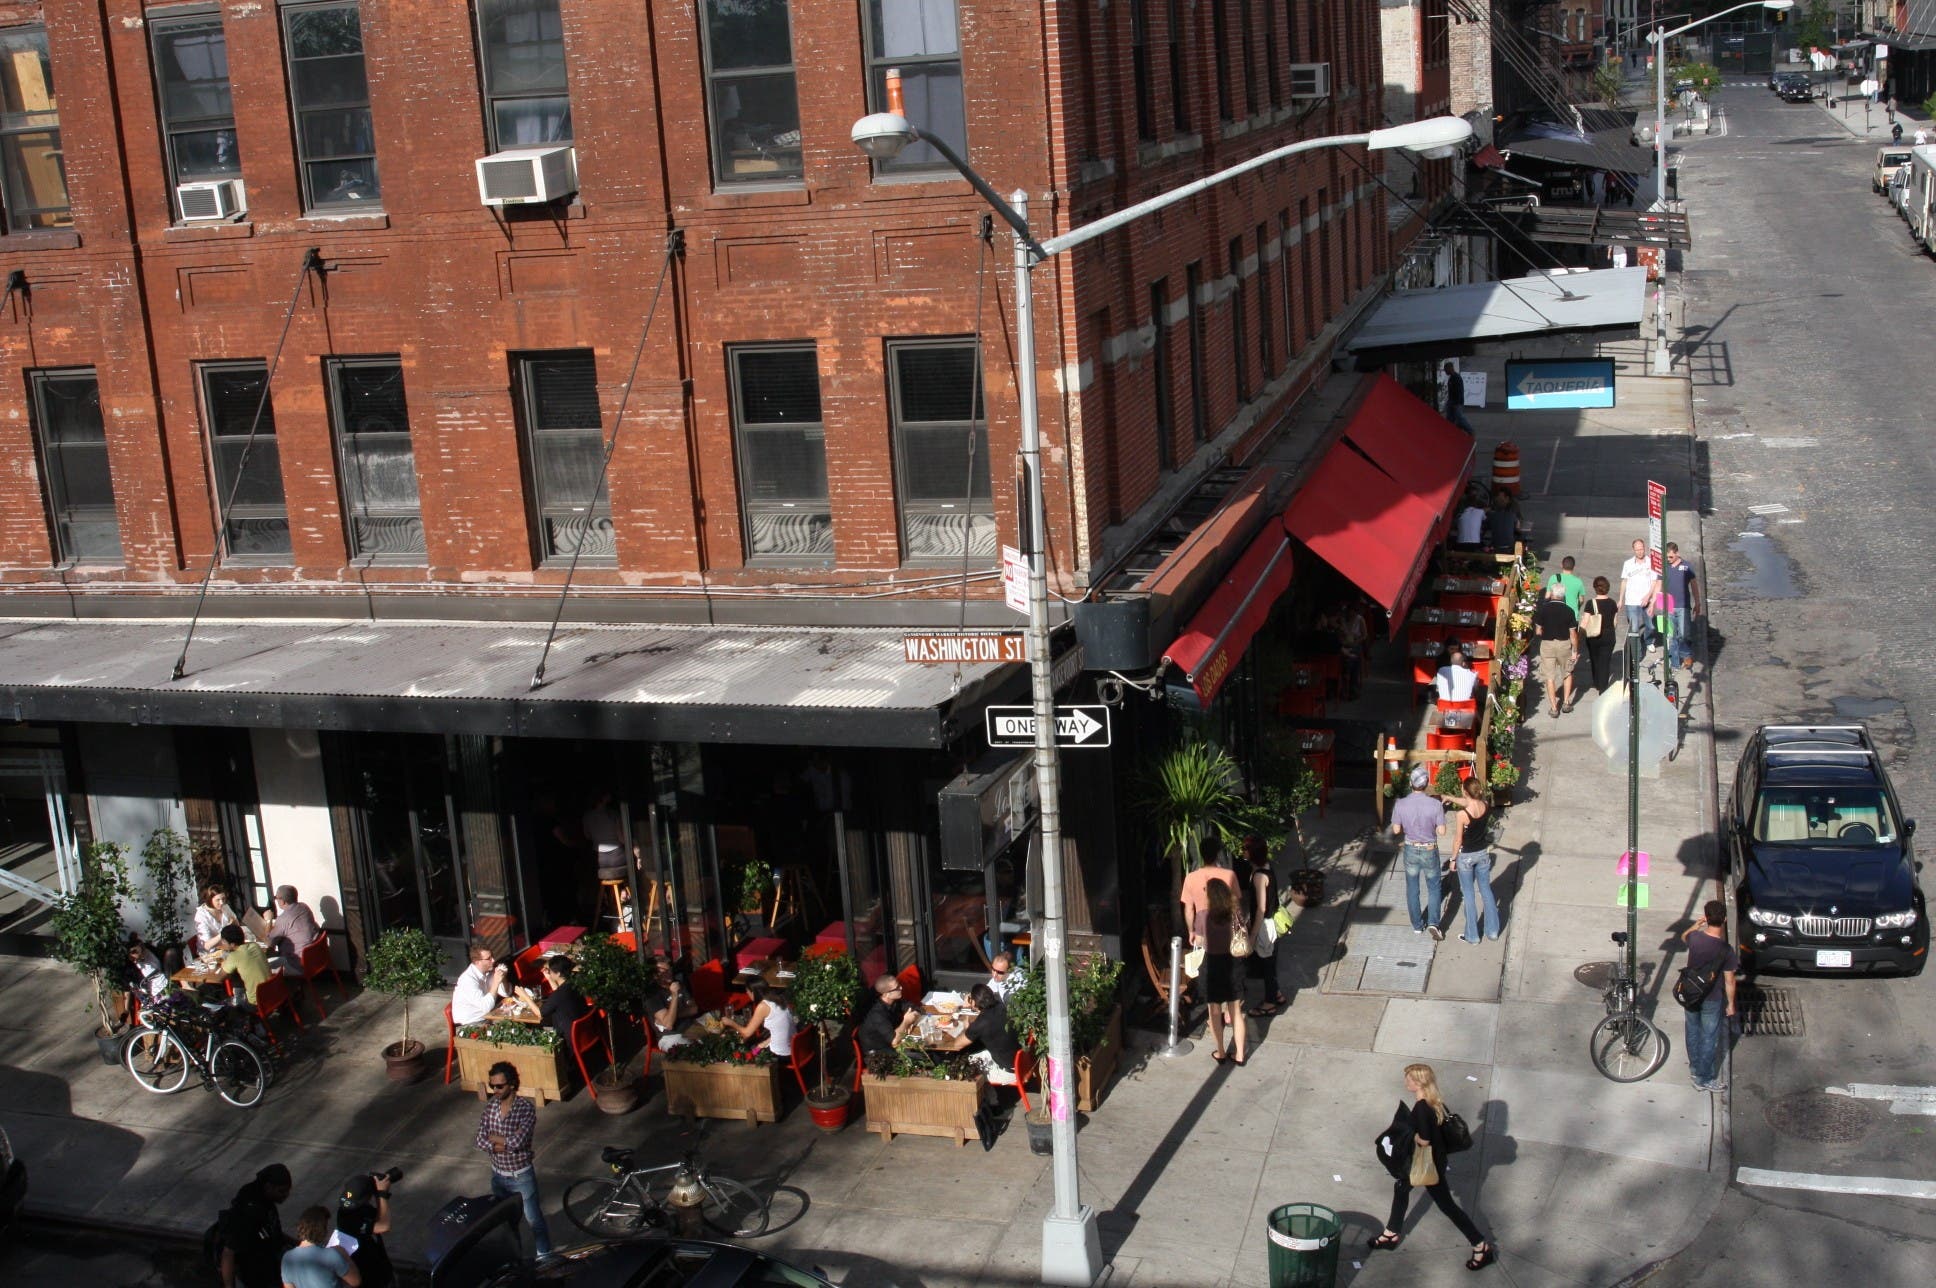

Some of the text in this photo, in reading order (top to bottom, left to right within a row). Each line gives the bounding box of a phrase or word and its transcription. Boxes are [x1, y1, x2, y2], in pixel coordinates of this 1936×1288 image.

[905, 638, 1022, 660] WASHINGTON ST
[1006, 719, 1090, 734] ONE WAY
